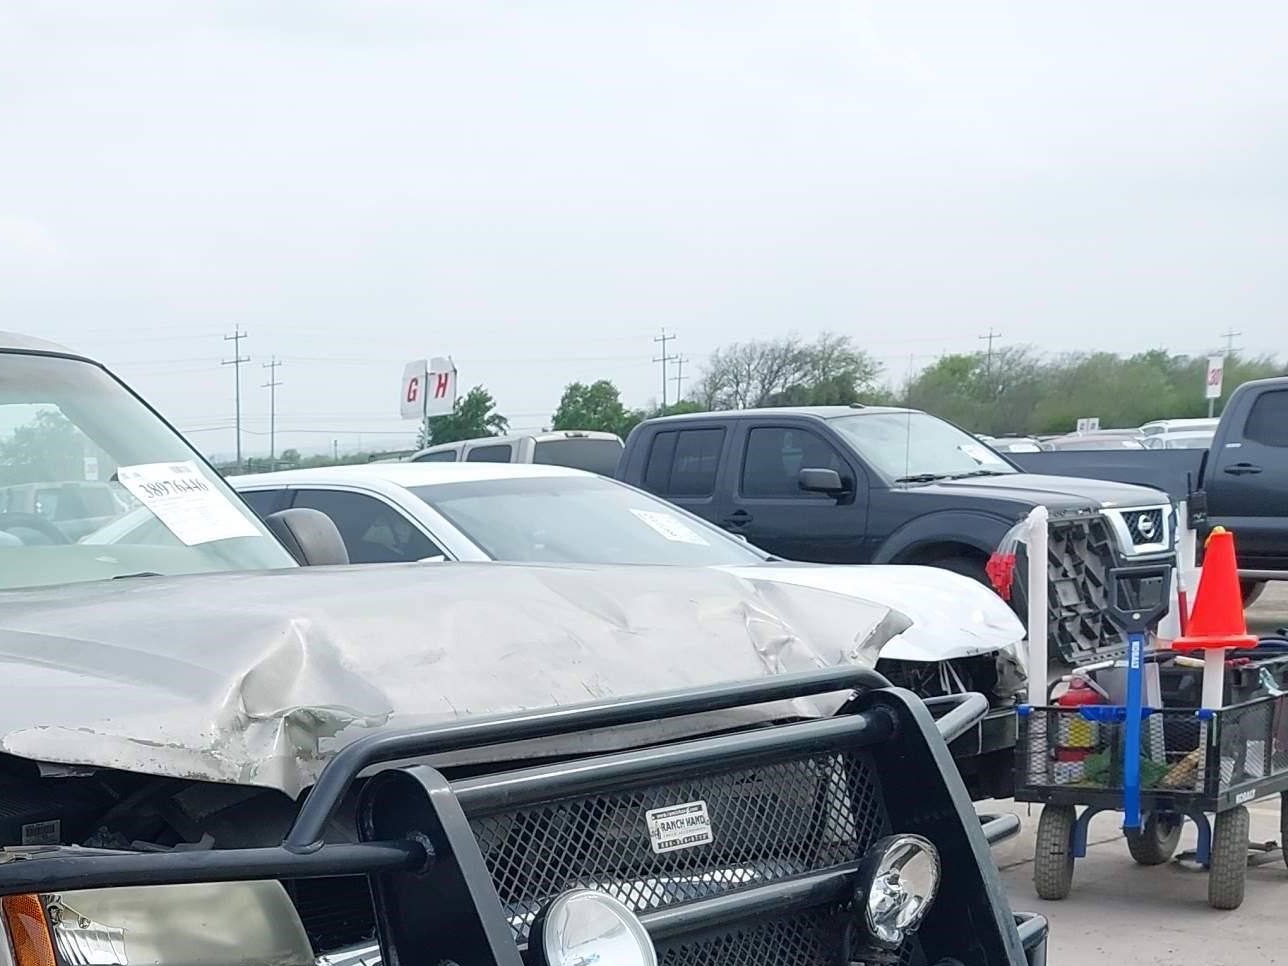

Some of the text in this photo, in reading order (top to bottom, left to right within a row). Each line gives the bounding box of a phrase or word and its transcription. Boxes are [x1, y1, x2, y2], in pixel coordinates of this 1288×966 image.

[407, 377, 419, 403] G
[434, 373, 448, 399] H
[138, 478, 209, 499] 38976446
[660, 815, 705, 832] RANCH HAND
